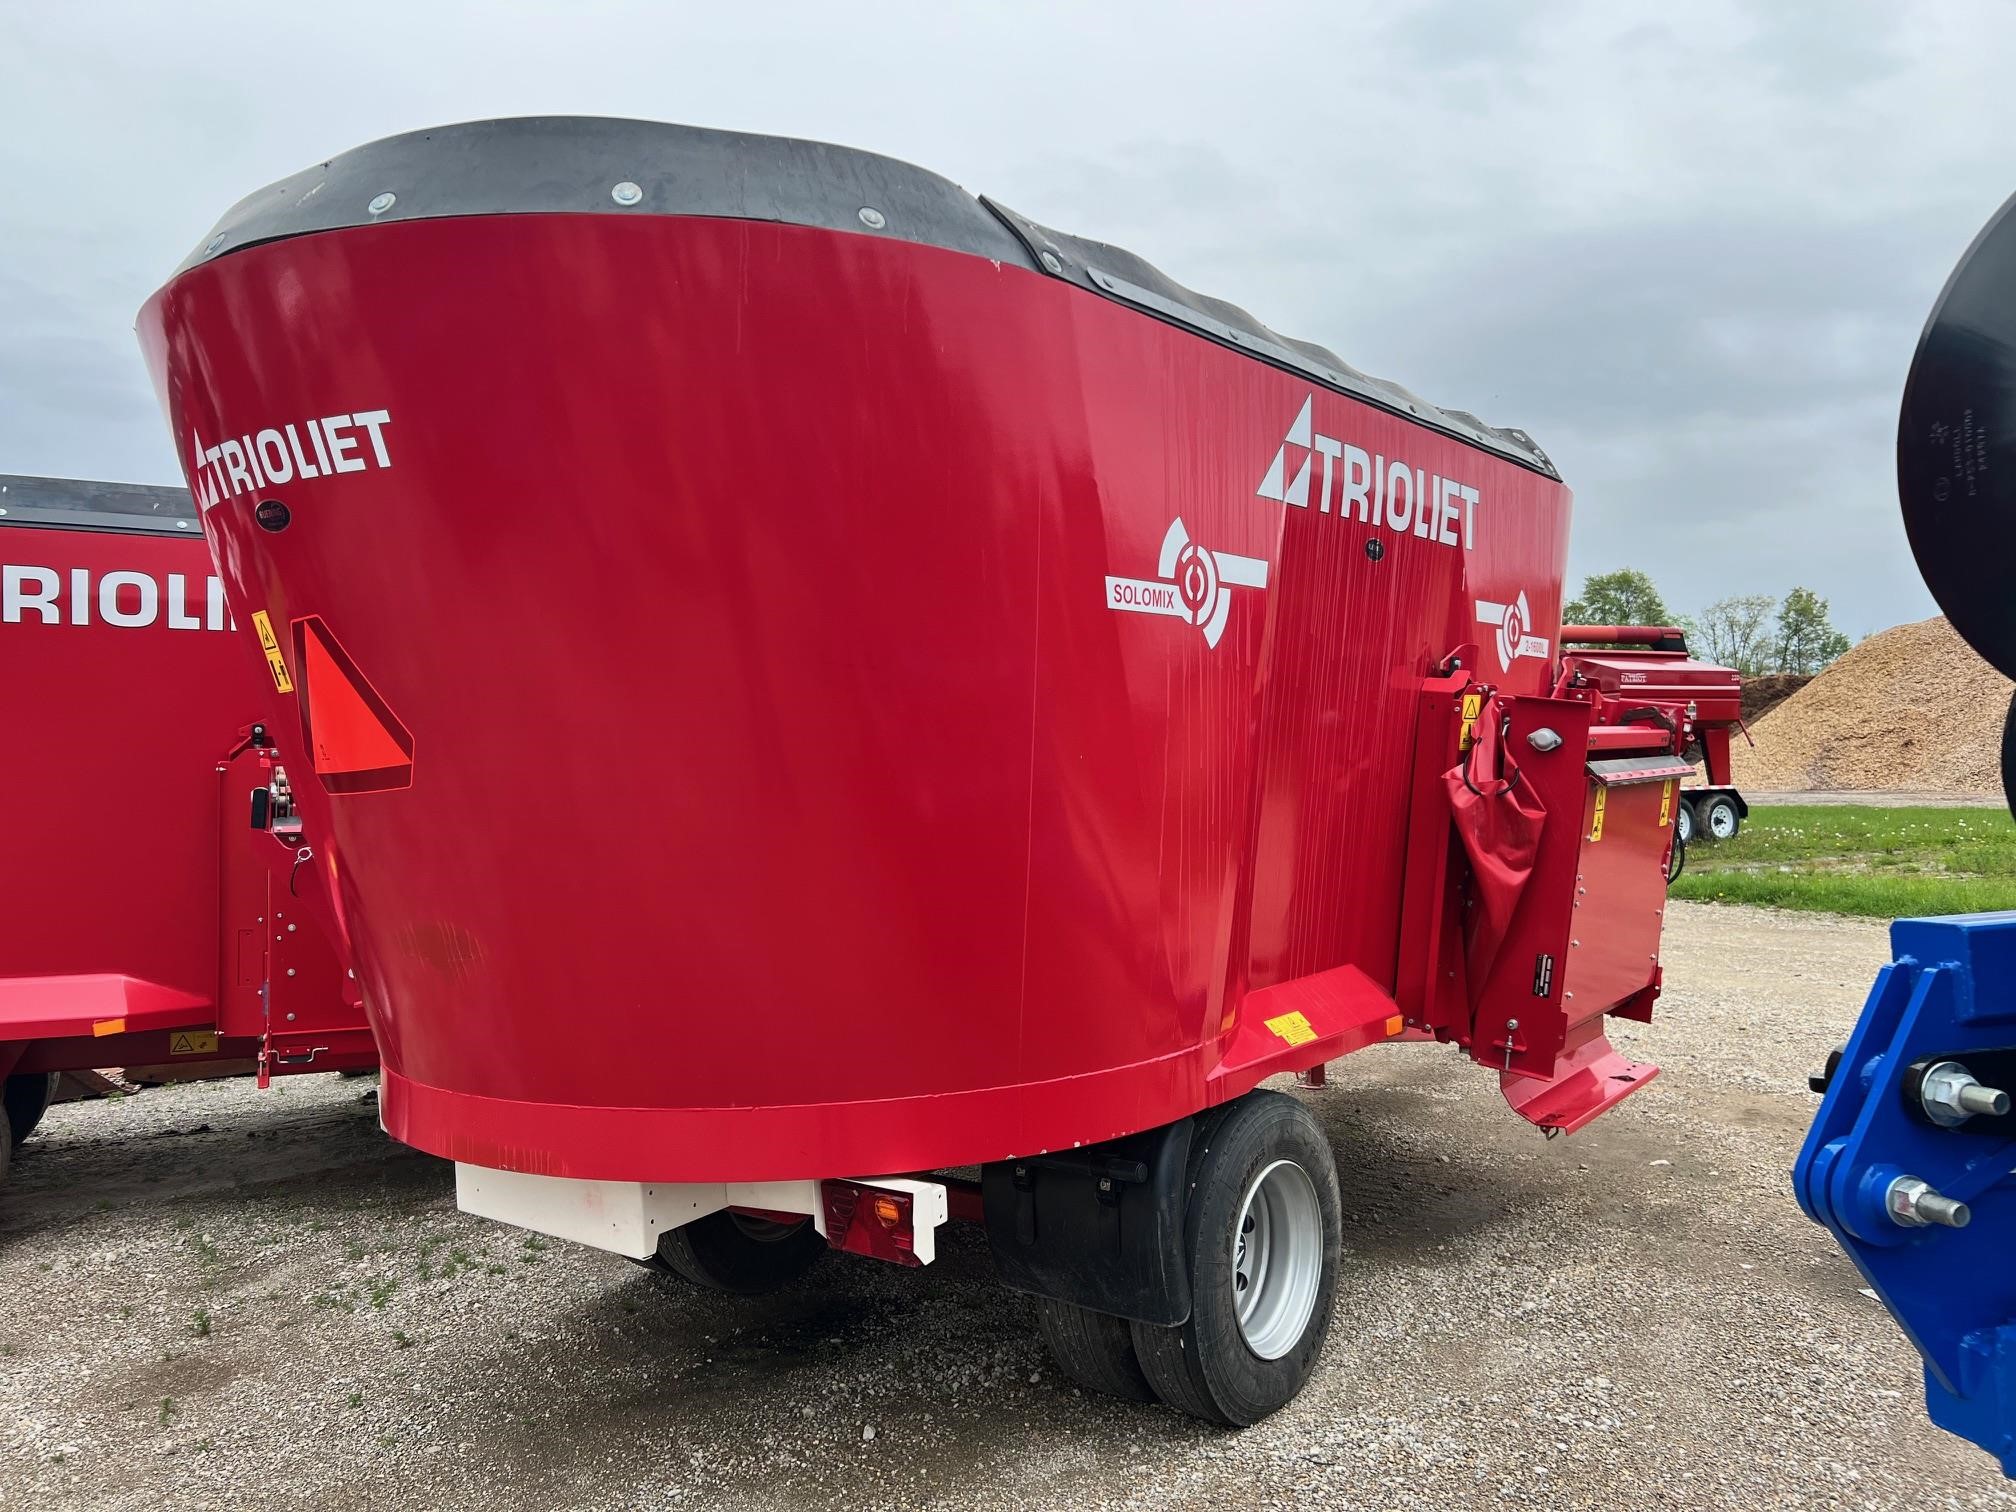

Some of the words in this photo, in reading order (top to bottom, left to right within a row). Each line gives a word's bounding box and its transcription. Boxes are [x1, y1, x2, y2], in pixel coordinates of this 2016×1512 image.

[205, 409, 391, 499] TRIOLIET
[1314, 433, 1480, 551] TRIOLIET
[2, 564, 237, 632] RIOLI
[1114, 584, 1175, 609] SOLOMIX
